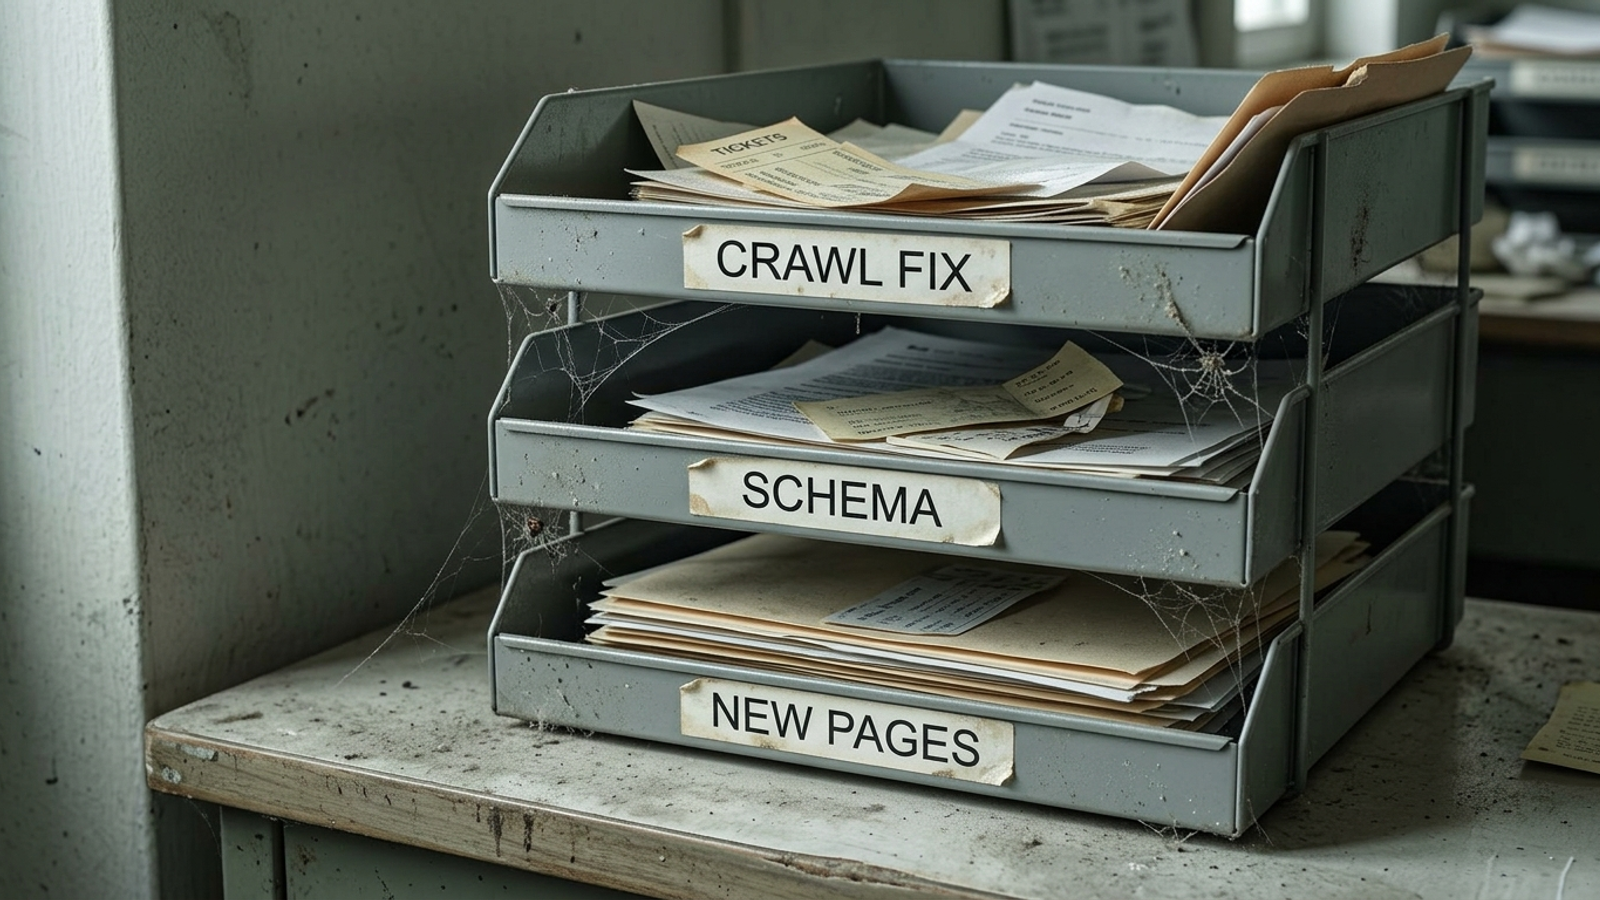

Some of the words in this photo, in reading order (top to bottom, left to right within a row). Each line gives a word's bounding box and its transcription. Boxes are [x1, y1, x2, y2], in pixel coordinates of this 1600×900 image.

[710, 133, 788, 156] TICKETS
[717, 240, 883, 287] CRAWL
[899, 250, 974, 294] FIX
[742, 471, 943, 528] SCHEMA
[712, 692, 813, 741] NEW
[828, 709, 980, 768] PAGES
